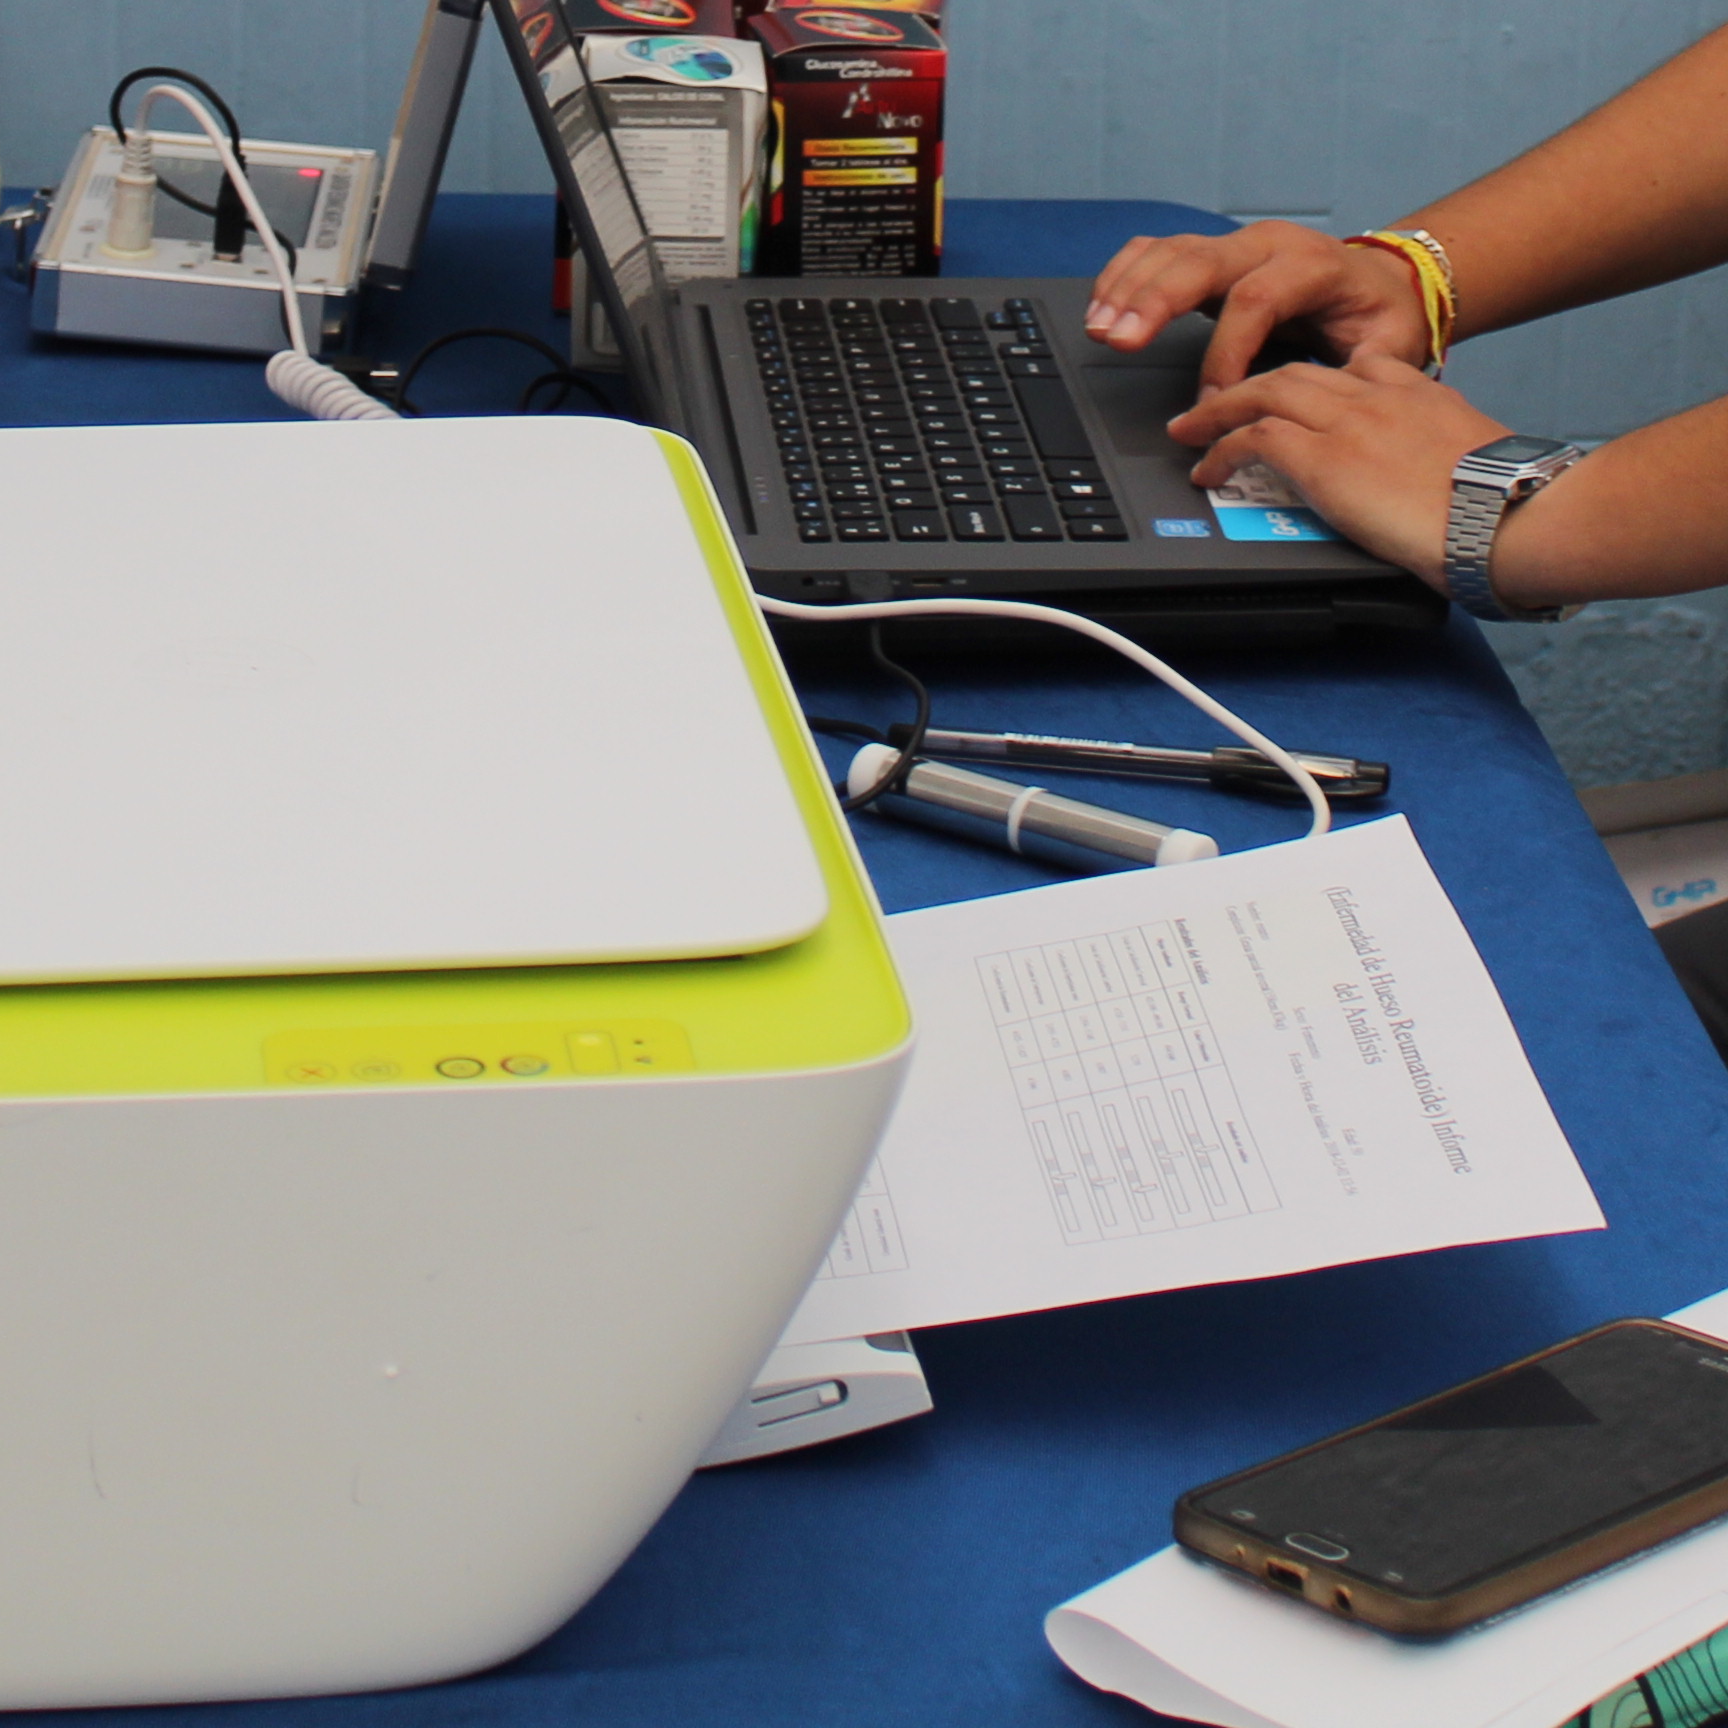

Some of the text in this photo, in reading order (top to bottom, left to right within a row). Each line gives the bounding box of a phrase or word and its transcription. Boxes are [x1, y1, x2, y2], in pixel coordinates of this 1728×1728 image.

[1325, 887, 1471, 1174] (Enfermedad de Hueso Reumatoide) Informe
[1333, 983, 1387, 1065] del Análisis
